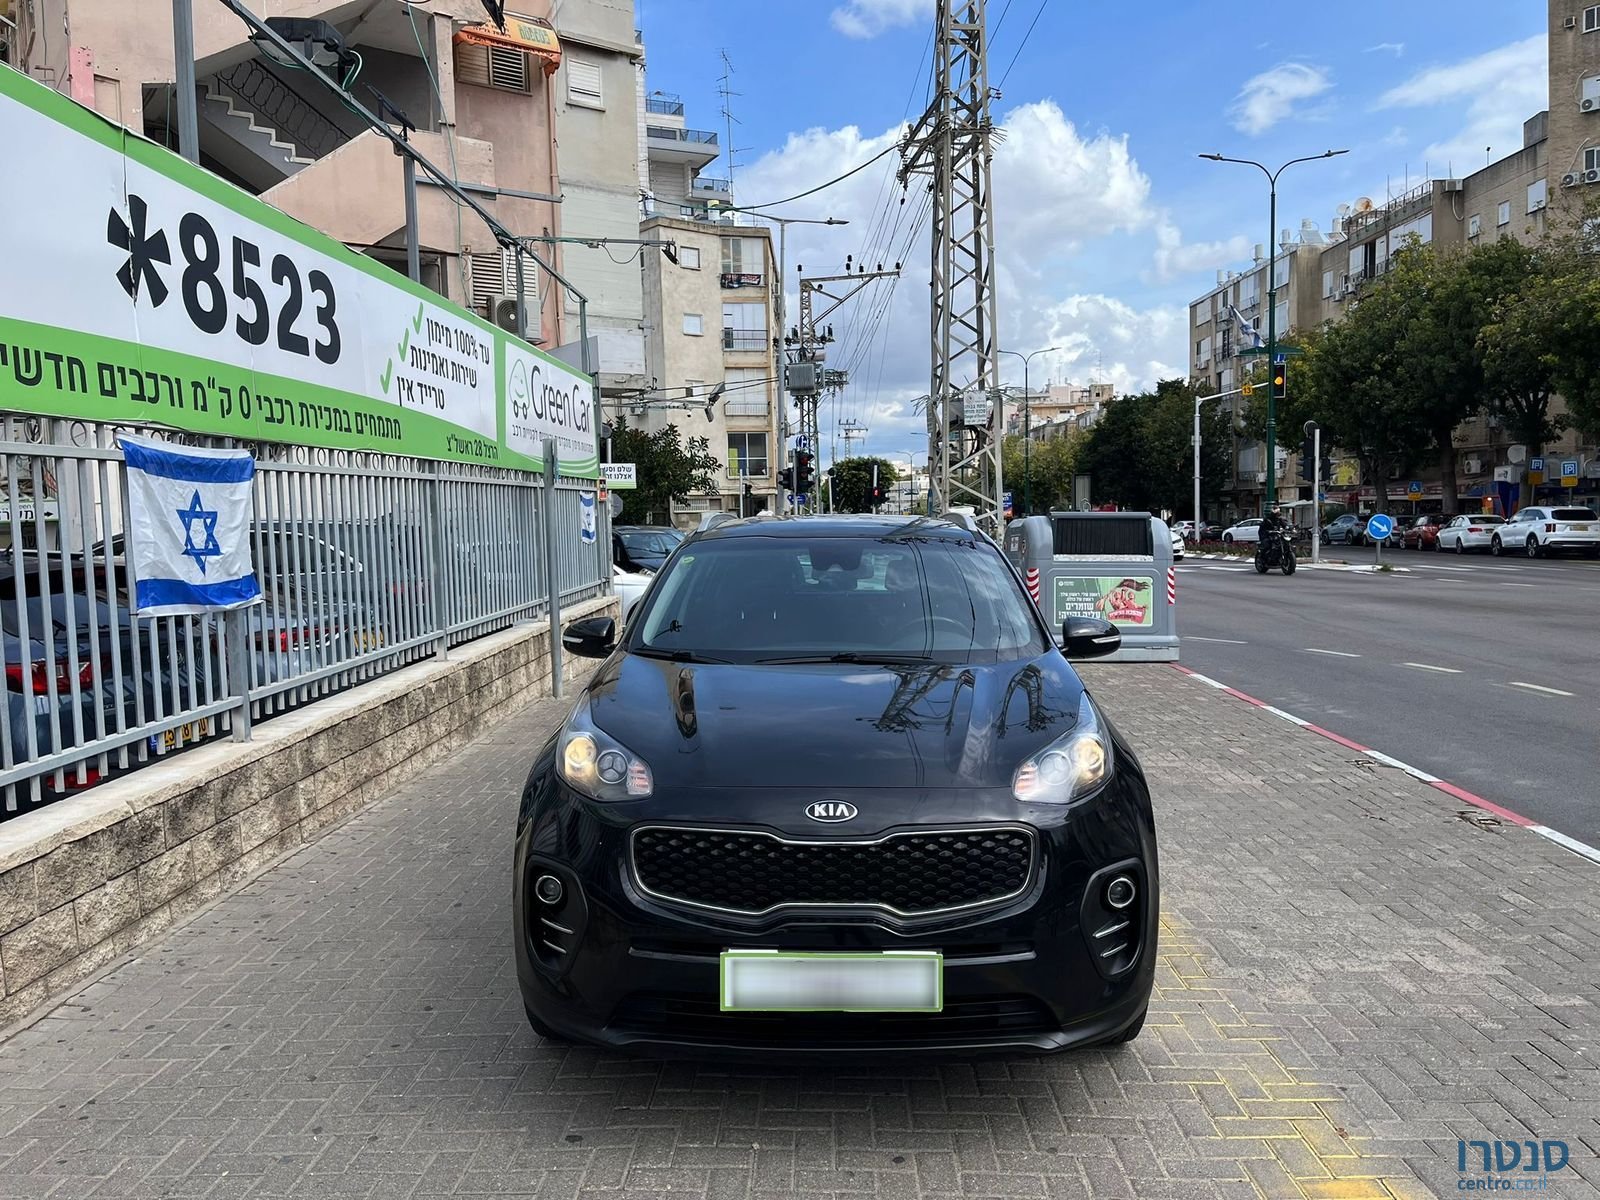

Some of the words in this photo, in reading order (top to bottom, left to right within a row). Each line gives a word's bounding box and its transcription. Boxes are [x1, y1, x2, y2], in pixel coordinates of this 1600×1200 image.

[426, 317, 452, 347] מימון
[454, 328, 478, 360] 100%
[410, 345, 449, 379] ואמינות
[479, 343, 490, 365] עד
[97, 361, 184, 409] ורכבים
[451, 360, 477, 389] שירות
[238, 385, 252, 420] 0
[396, 375, 415, 407] אין
[417, 382, 445, 410] טרייד
[531, 364, 571, 428] Green
[572, 384, 590, 433] Car
[255, 394, 295, 426] רכבי
[299, 402, 352, 433] במכירת
[354, 411, 401, 440] מתמחים
[475, 439, 483, 457] 28
[617, 465, 632, 473] שלם
[1065, 602, 1094, 611] שומרים
[814, 803, 850, 817] KIA
